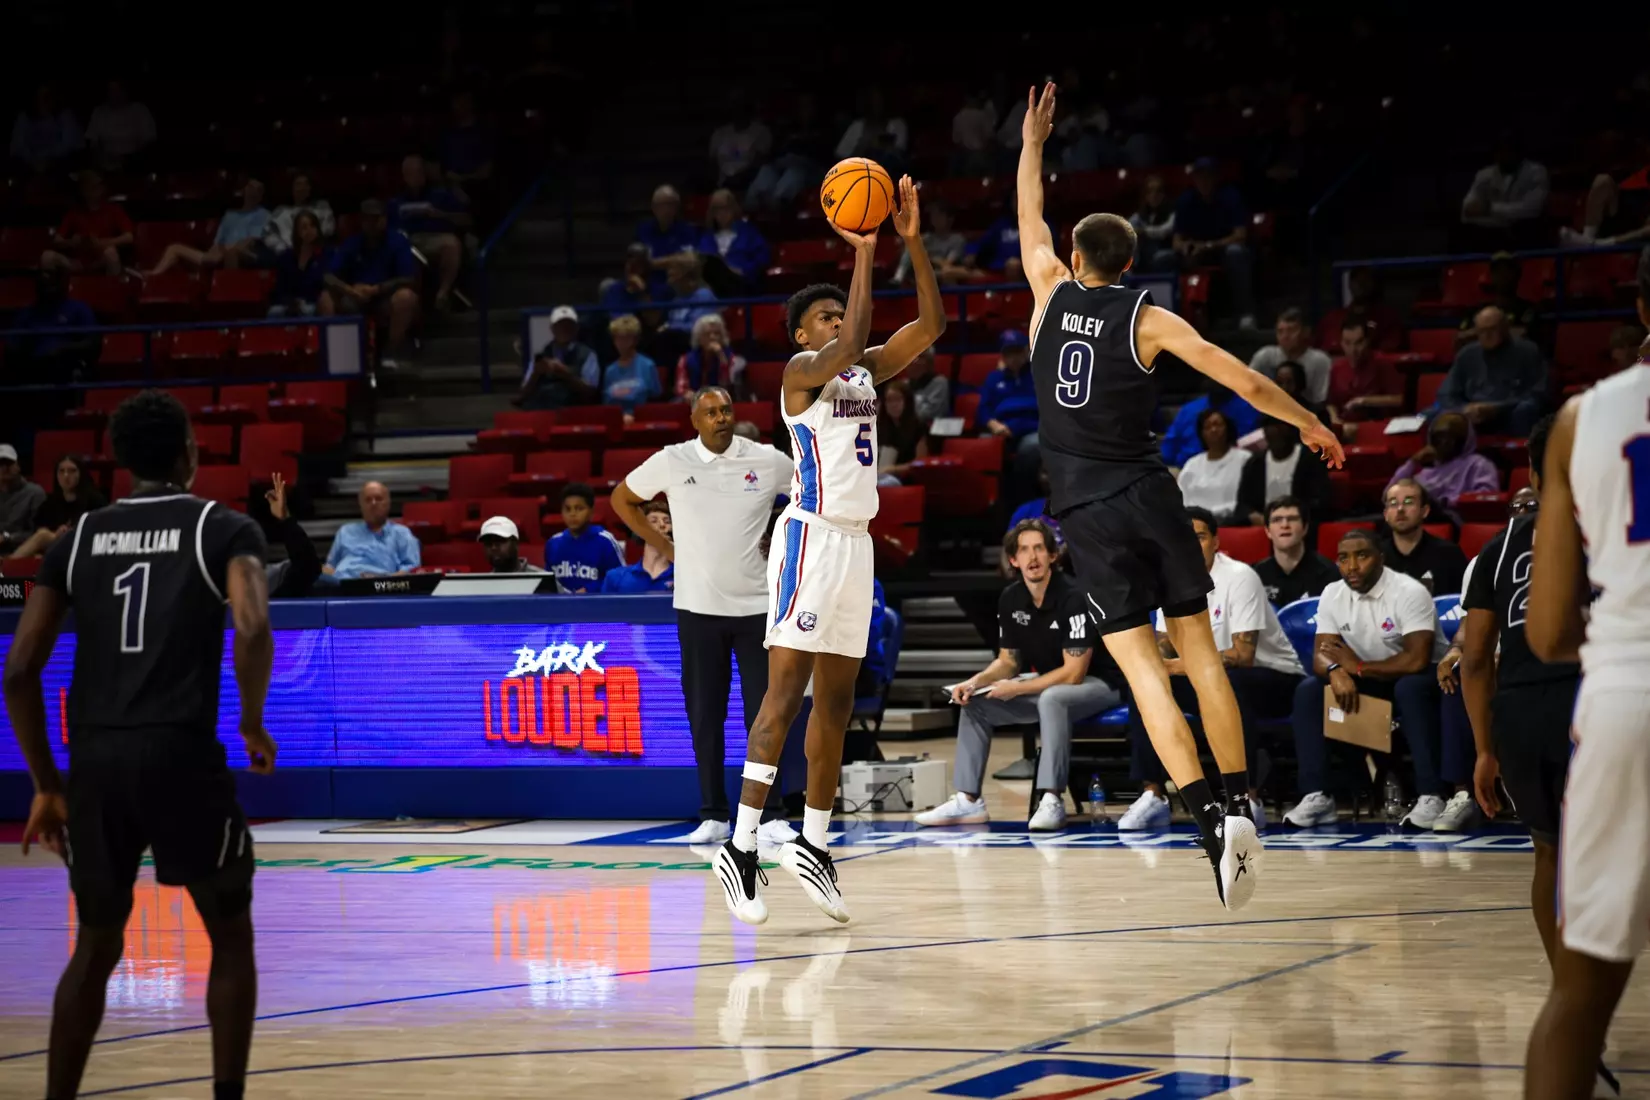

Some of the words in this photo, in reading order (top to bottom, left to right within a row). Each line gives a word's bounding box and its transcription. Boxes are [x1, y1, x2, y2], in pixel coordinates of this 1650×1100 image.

[1061, 312, 1104, 338] KOLEV
[1055, 340, 1094, 409] 9
[854, 422, 874, 467] 5
[91, 528, 181, 557] MCMILLIAN
[112, 561, 151, 654] 1
[505, 640, 610, 678] BARK
[483, 666, 644, 755] LOUDER
